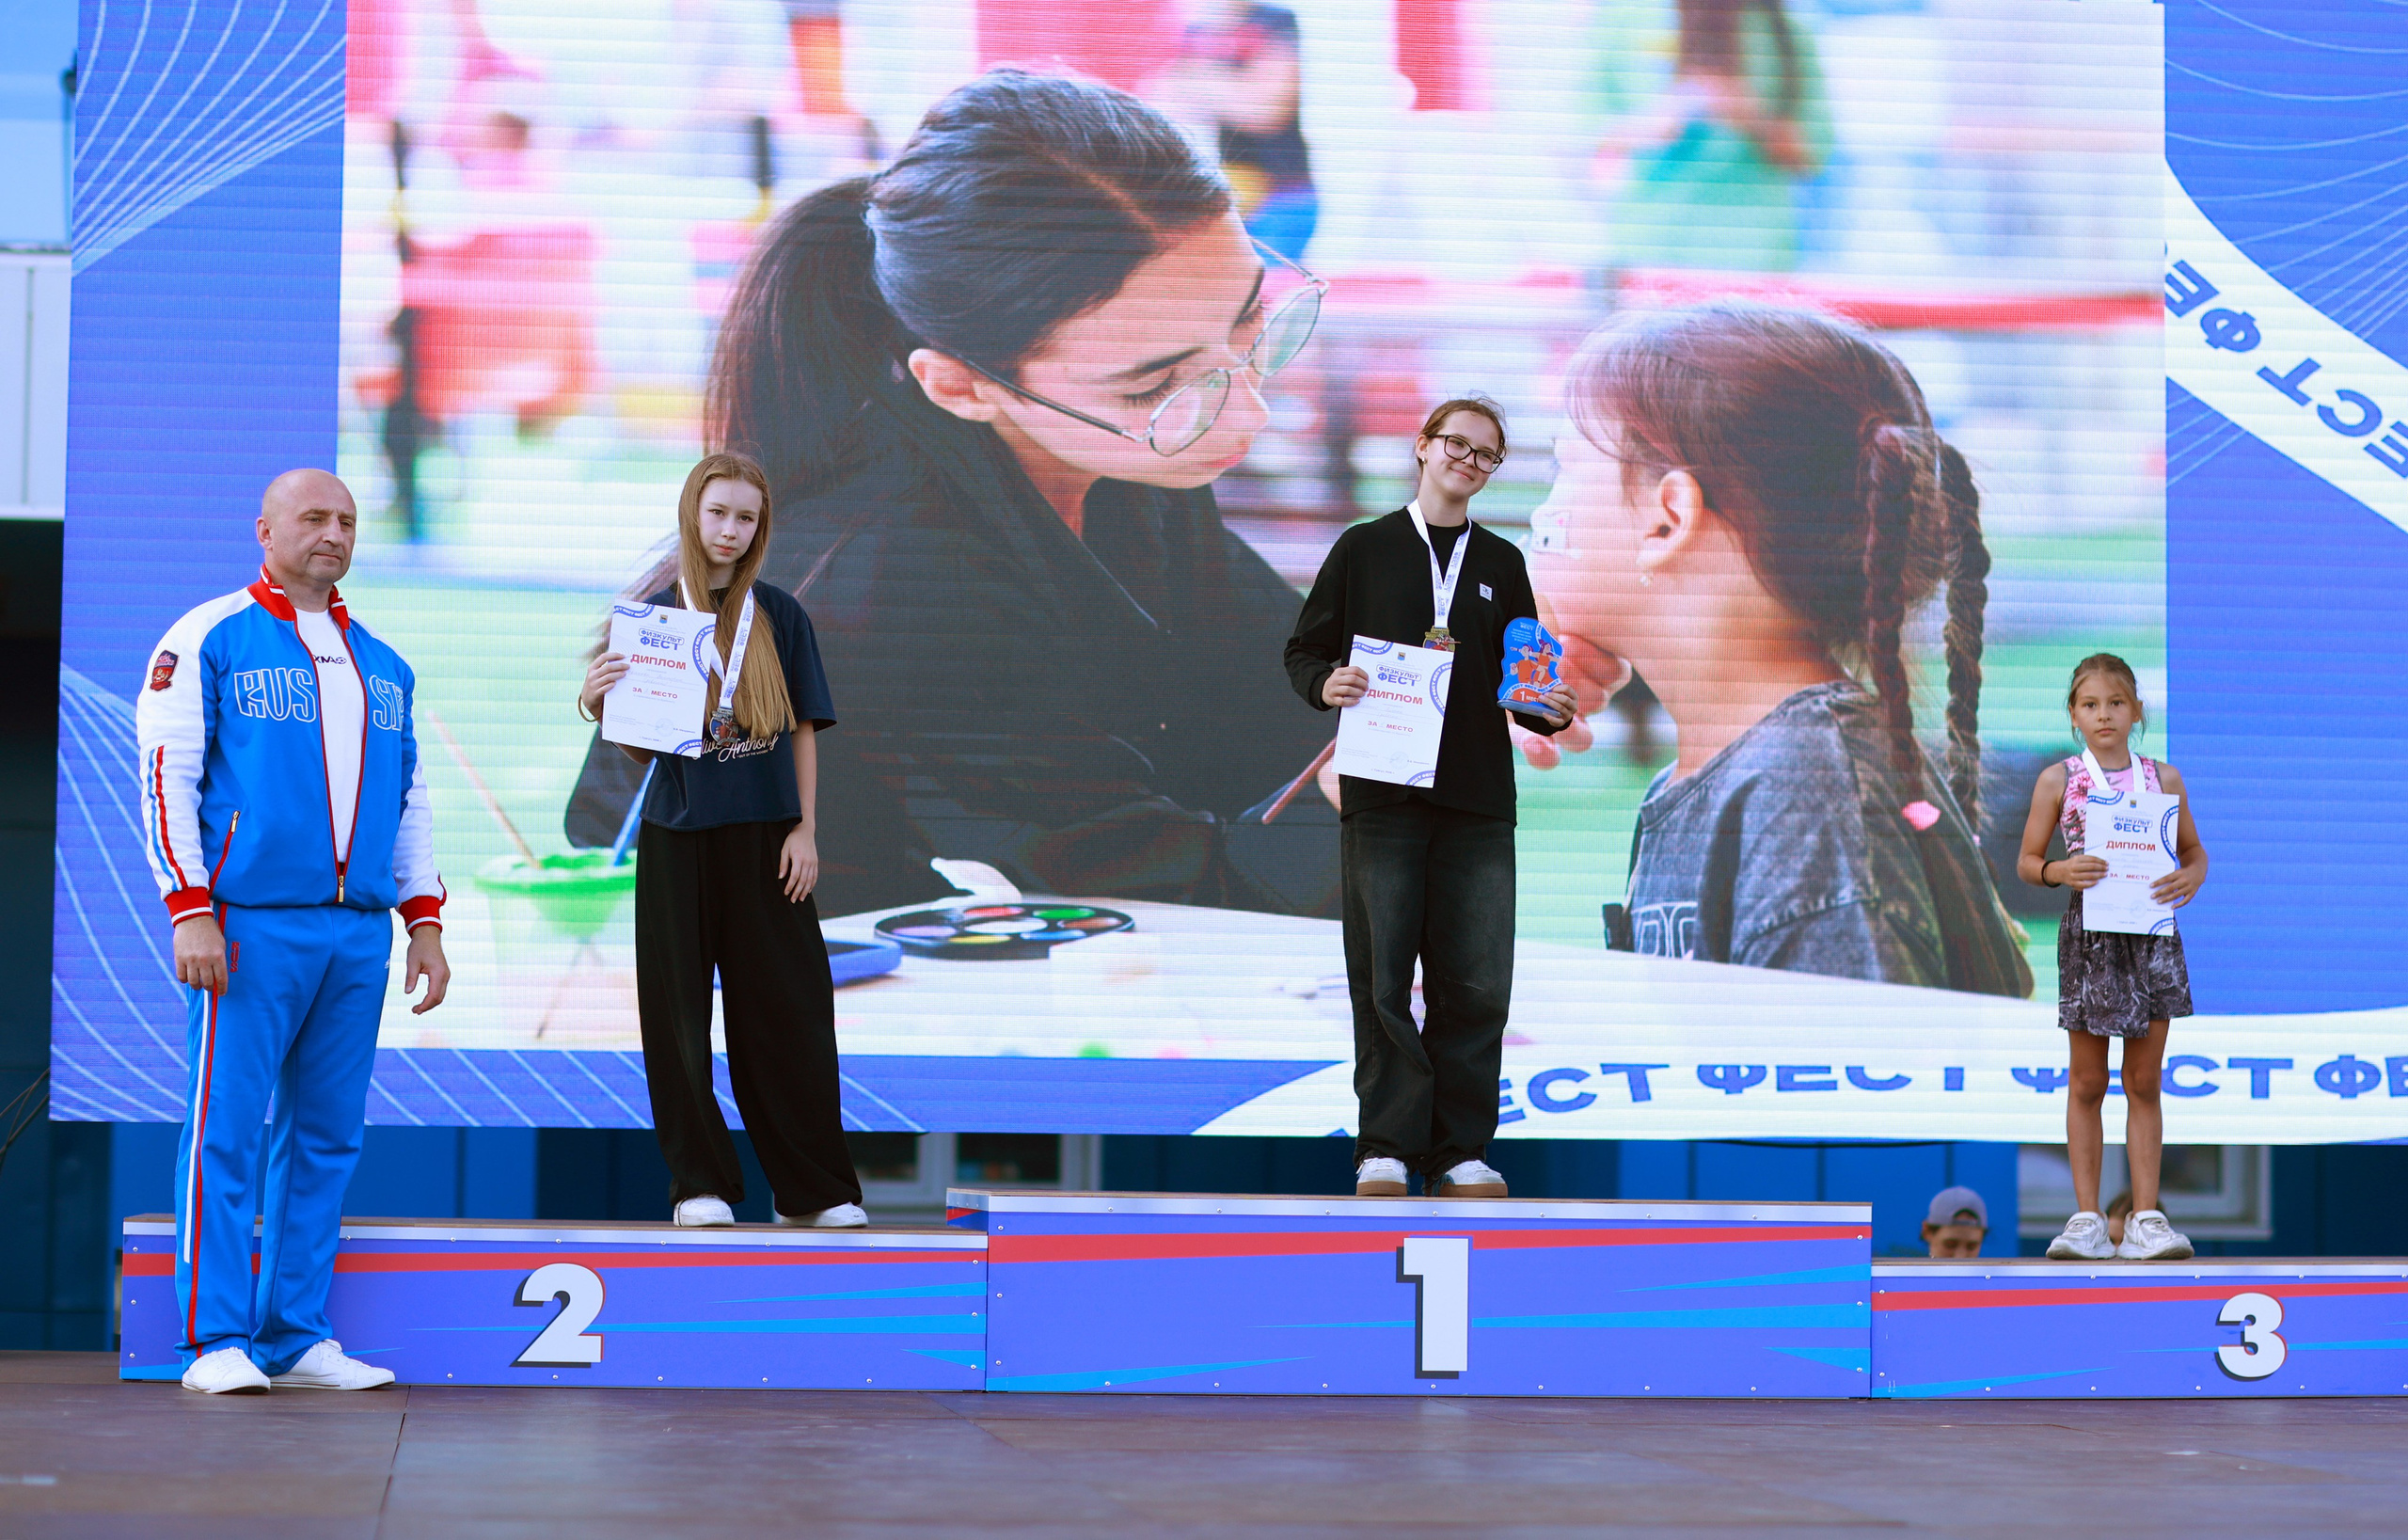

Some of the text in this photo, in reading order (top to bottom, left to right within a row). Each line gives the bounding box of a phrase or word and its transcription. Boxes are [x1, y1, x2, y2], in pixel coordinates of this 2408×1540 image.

[640, 636, 678, 650] ФЕСТ
[641, 630, 682, 643] ФИЗКУЛЬТ
[630, 654, 686, 670] ДИПЛОМ
[1379, 666, 1419, 679] ФИЗКУЛЬТ
[1377, 673, 1416, 687] ФЕСТ
[651, 690, 678, 699] МЕСТО
[1367, 689, 1423, 705] ДИПЛОМ
[1520, 691, 1526, 701] 1
[1386, 723, 1414, 733] МЕСТО
[2114, 817, 2150, 826] ФИЗКУЛЬТ
[2114, 822, 2147, 834] ФЕСТ
[2106, 840, 2156, 851] ДИПЛОМ
[230, 942, 240, 973] RUS
[1498, 1063, 1670, 1125] СТ
[1402, 1237, 1469, 1372] 1
[516, 1262, 604, 1363] 2
[2217, 1292, 2286, 1378] 3
